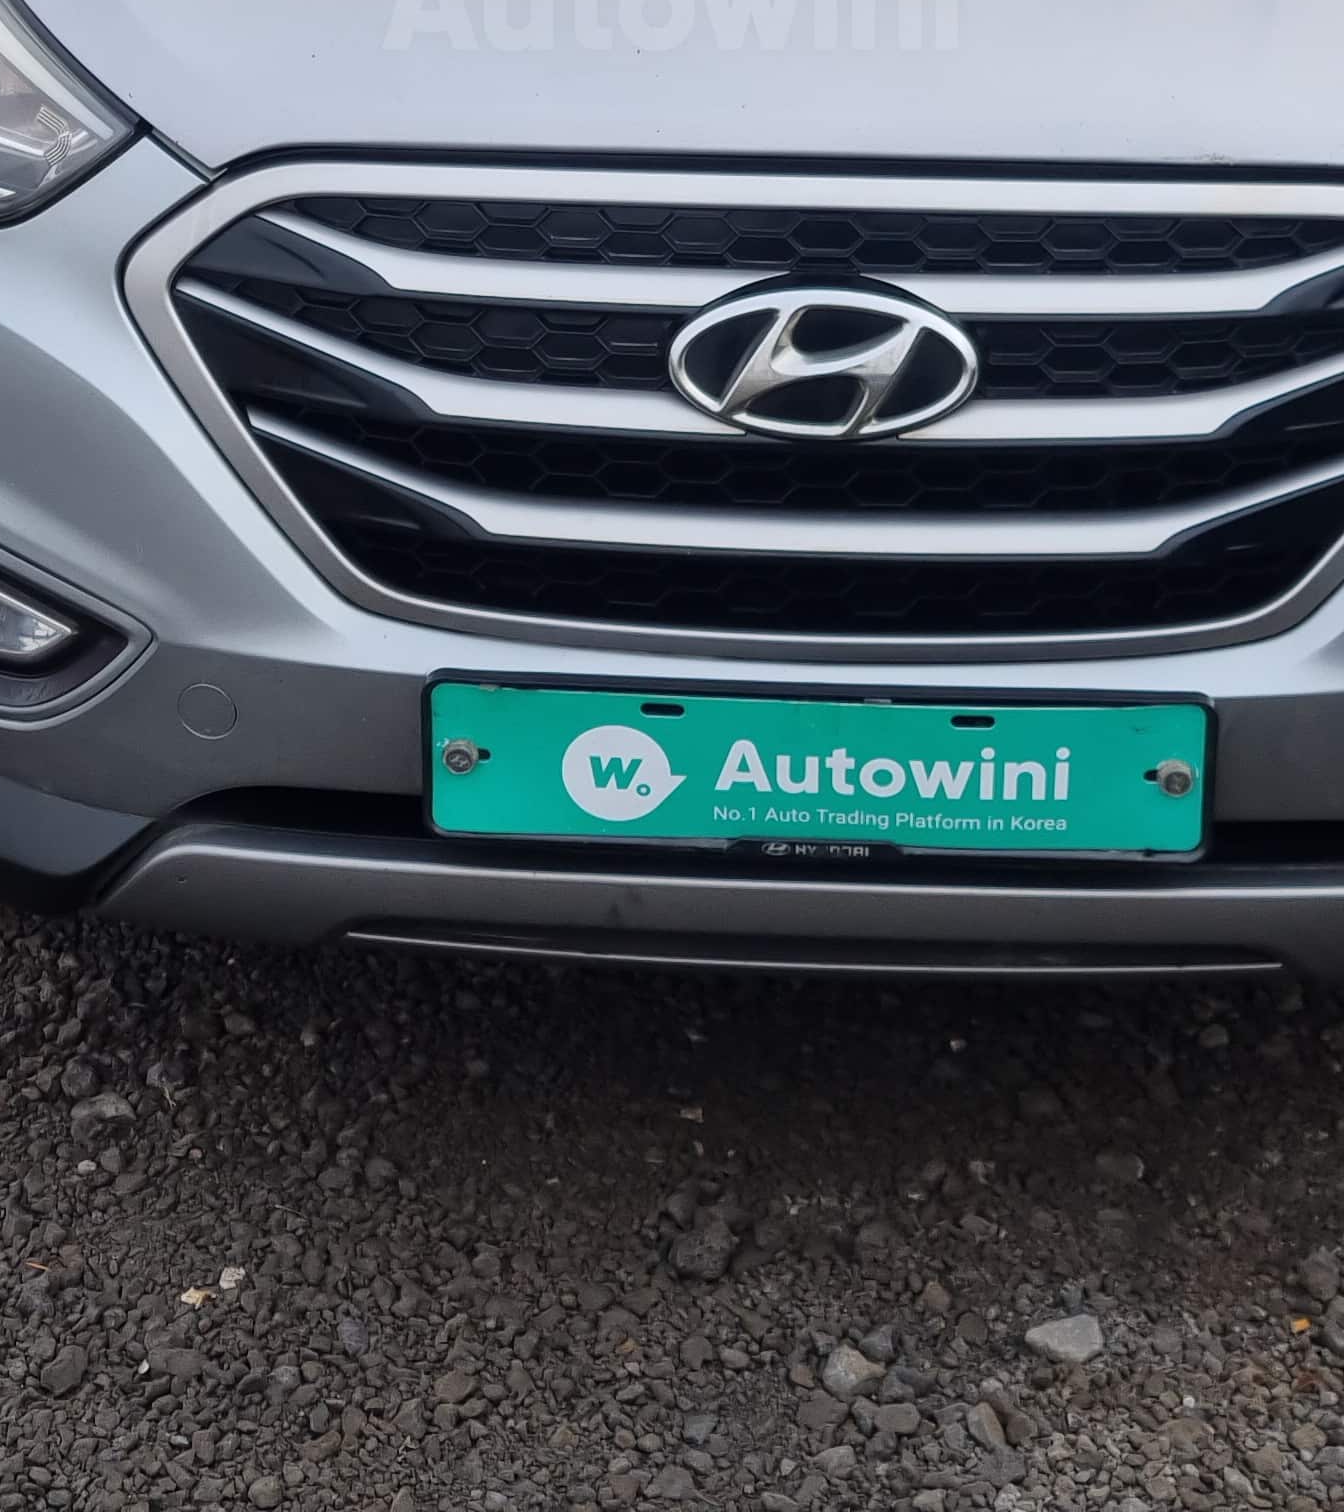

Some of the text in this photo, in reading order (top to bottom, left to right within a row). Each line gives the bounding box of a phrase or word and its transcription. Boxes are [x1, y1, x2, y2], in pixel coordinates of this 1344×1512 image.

[714, 739, 1071, 801] Autowini
[764, 807, 810, 823] Auto
[816, 808, 889, 829] Trading
[895, 812, 981, 831] Platform
[987, 816, 1004, 830] in
[1010, 816, 1067, 831] Korea
